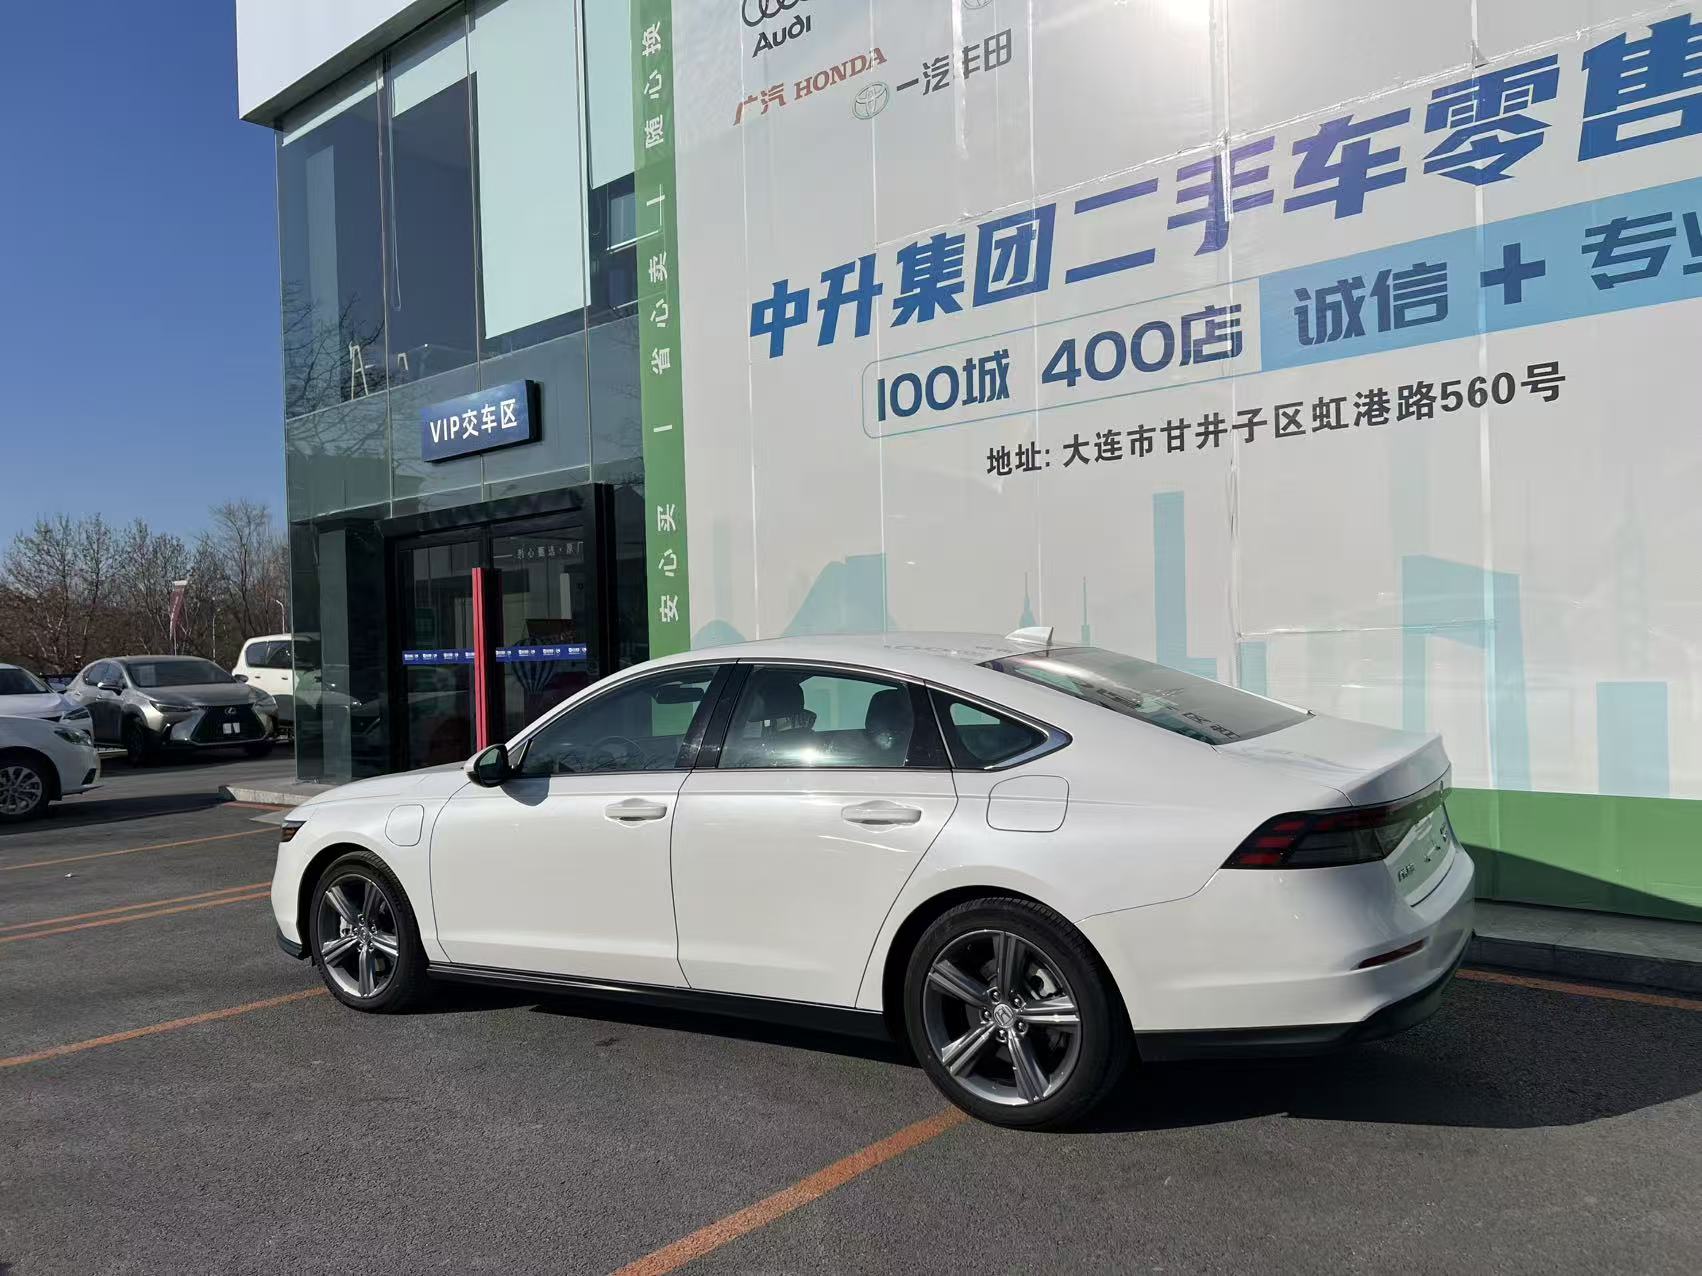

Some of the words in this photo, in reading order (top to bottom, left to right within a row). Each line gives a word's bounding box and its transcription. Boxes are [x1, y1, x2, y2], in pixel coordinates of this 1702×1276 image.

[642, 21, 664, 148] 随心换
[733, 83, 786, 126] 广汽
[794, 47, 887, 101] HONDA
[752, 14, 811, 58] Audi
[649, 252, 671, 374] 省心卖
[1294, 262, 1448, 346] 诚信
[877, 348, 1010, 422] 100城
[1041, 303, 1243, 388] 400店
[429, 398, 518, 443] VIP交车区
[657, 503, 679, 622] 安心买
